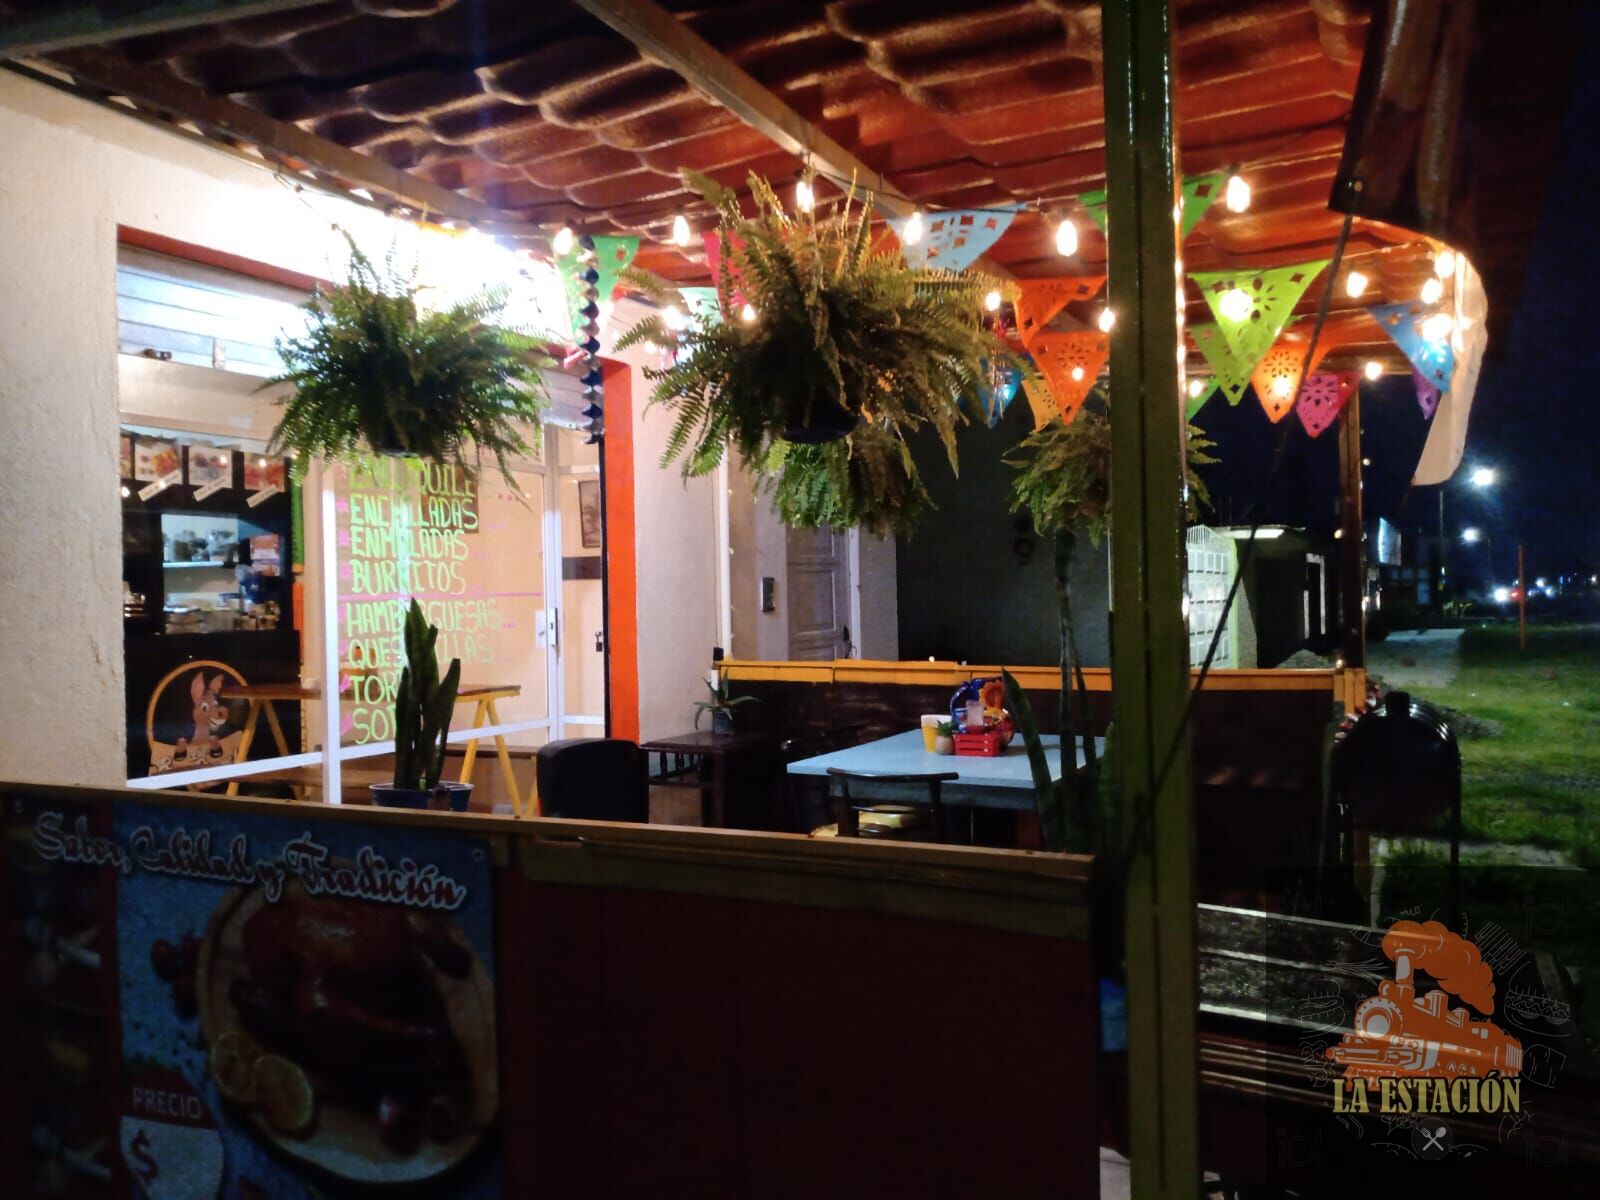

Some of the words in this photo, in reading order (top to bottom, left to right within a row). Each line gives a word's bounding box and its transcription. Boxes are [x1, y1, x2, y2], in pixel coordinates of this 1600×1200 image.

[350, 558, 466, 596] BURRITOS
[346, 598, 502, 637] HAMBGUESAS
[348, 632, 493, 669] QUESLLAS
[130, 827, 257, 884] Calidad
[254, 858, 286, 903] y
[283, 831, 467, 911] Tradición
[132, 1087, 203, 1119] PRECIO
